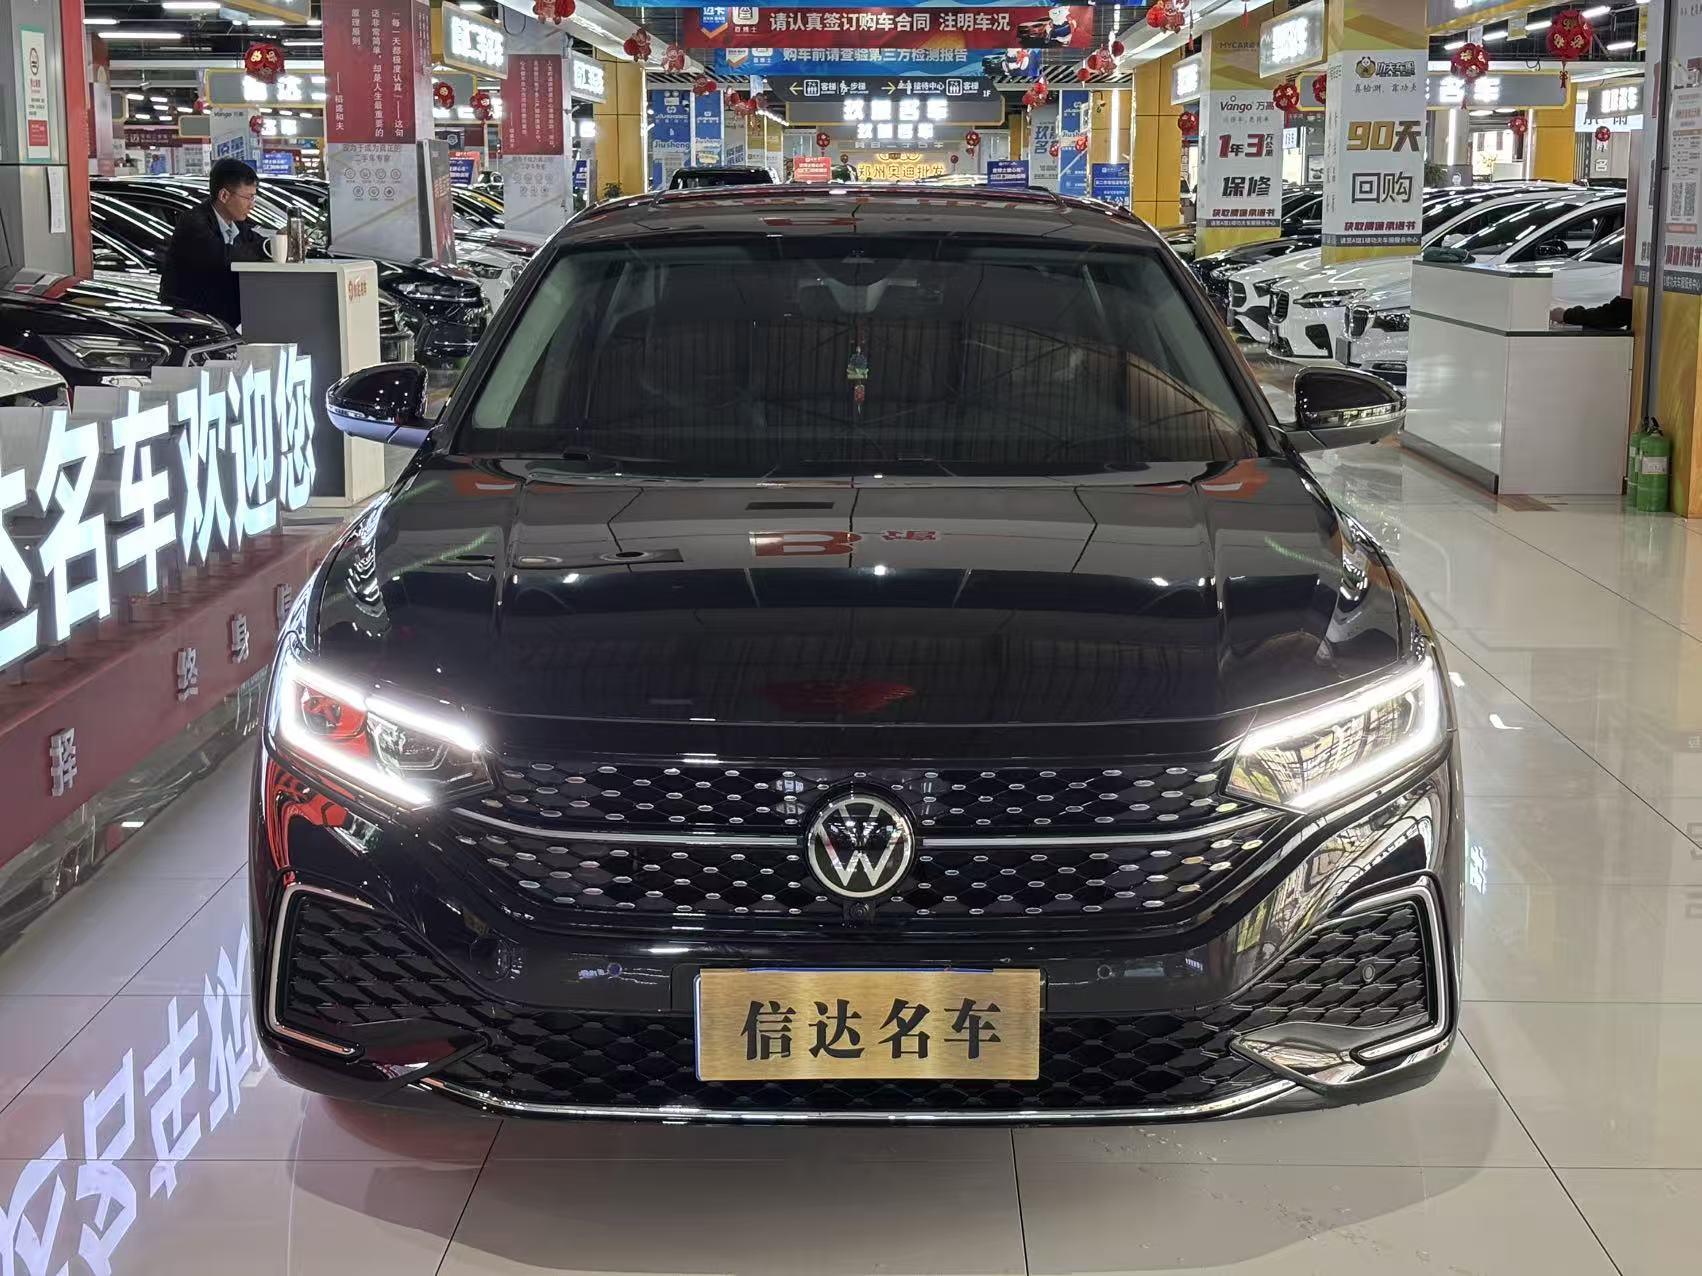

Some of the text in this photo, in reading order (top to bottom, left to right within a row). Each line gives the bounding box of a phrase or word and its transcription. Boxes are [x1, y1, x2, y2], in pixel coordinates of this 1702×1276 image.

[770, 13, 1010, 31] 请认真签订购车合同 注明车况
[783, 48, 968, 62] 购车前请查验第三方检测报告
[821, 82, 866, 91] 客梯 步梯
[913, 81, 979, 91] 接待中心 客梯
[1220, 101, 1252, 113] Vango
[1347, 120, 1421, 152] 90天
[858, 163, 945, 181] 郑州奥迪批发
[1222, 176, 1271, 197] 保修
[1352, 172, 1413, 203] 回购
[741, 998, 1001, 1060] 信达名车
